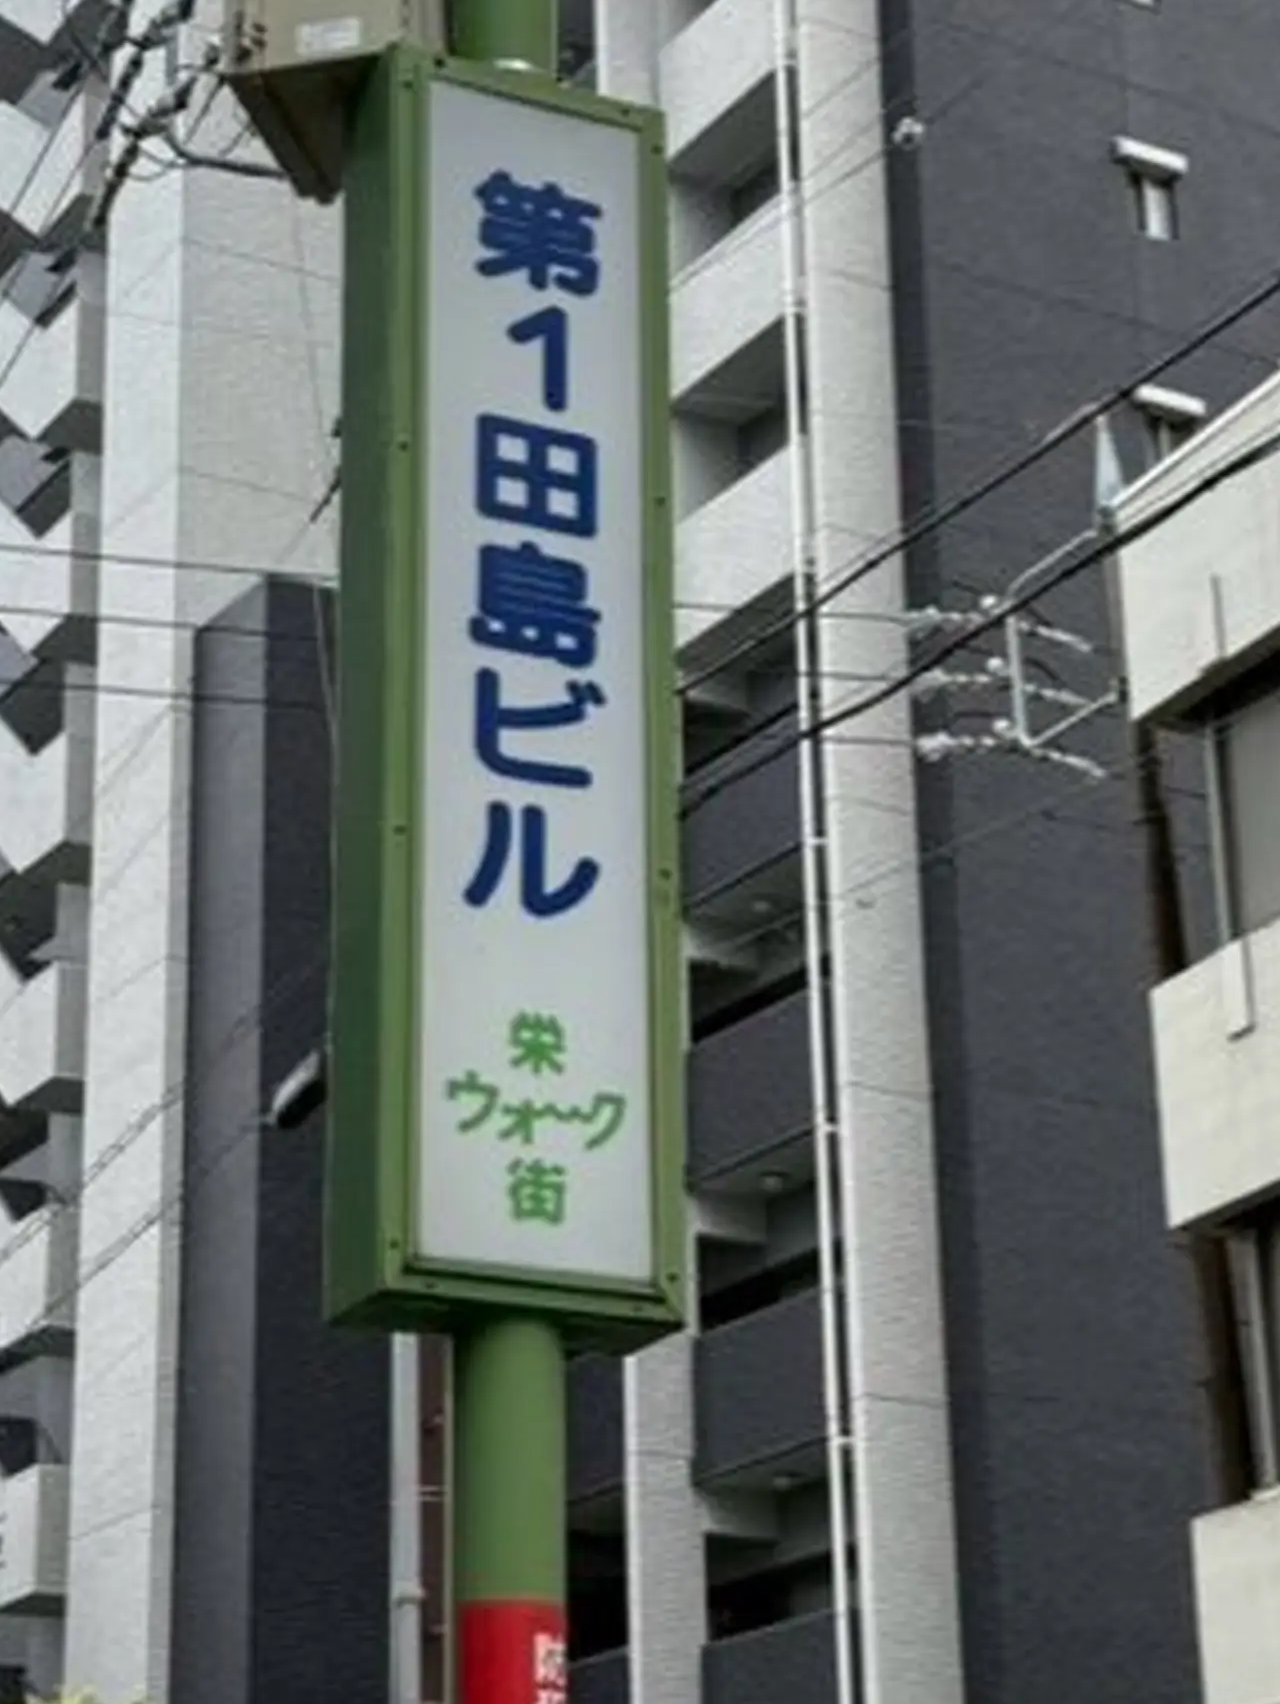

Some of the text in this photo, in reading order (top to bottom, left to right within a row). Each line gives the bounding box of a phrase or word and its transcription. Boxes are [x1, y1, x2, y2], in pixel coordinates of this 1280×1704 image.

[462, 168, 607, 918] 第1田島ビル
[508, 1008, 566, 1075] 栄
[444, 1069, 627, 1151] ウォーク
[506, 1156, 566, 1226] 街
